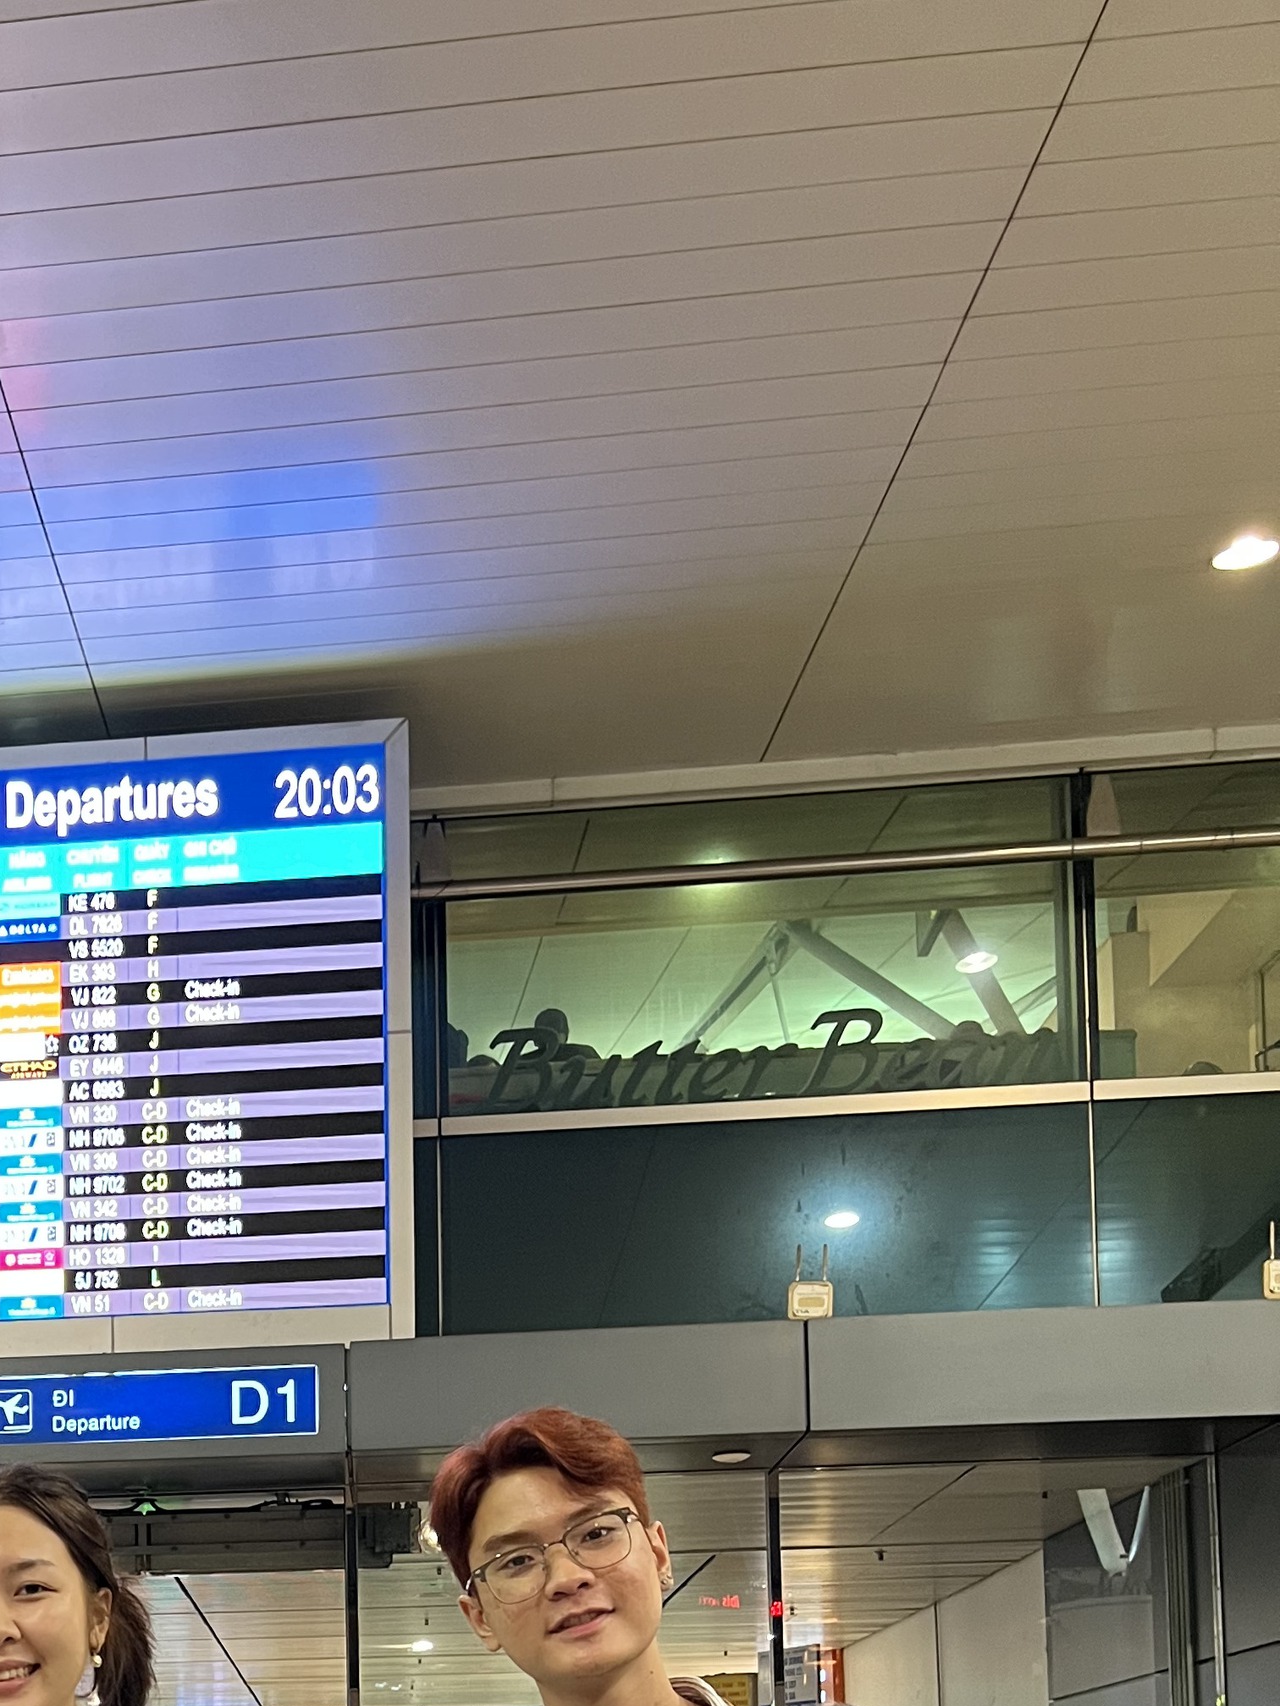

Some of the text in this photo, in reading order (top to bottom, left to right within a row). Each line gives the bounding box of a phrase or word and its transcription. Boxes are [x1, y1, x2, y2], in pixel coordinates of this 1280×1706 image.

[5, 775, 219, 838] Departures
[274, 766, 380, 819] 20:03
[68, 894, 88, 912] KE
[147, 889, 158, 907] F
[69, 918, 88, 936] DL
[147, 913, 158, 931] F
[147, 936, 158, 954] F
[147, 960, 159, 978] H
[71, 989, 90, 1007] VJ
[147, 984, 161, 1002] G
[185, 979, 240, 999] Check-in
[71, 1013, 89, 1031] VJ
[147, 1008, 161, 1026] G
[185, 1003, 240, 1023] Check-in
[69, 1036, 89, 1054] OZ
[149, 1031, 159, 1049] J
[0, 1060, 58, 1074] ETIHAD
[70, 1060, 89, 1078] EY
[149, 1055, 159, 1073] J
[489, 1026, 797, 1102] Butter
[69, 1083, 90, 1101] AC
[149, 1079, 159, 1097] J
[70, 1107, 89, 1125] VN
[93, 1105, 116, 1124] 320
[142, 1103, 168, 1121] C-D
[186, 1098, 241, 1118] Check-in
[69, 1131, 90, 1149] NH
[142, 1126, 168, 1144] C-D
[186, 1122, 241, 1142] Check-in
[70, 1154, 90, 1172] VN
[142, 1150, 168, 1168] C-D
[187, 1146, 241, 1166] Check-in
[69, 1178, 91, 1196] NH
[142, 1174, 168, 1192] C-D
[187, 1169, 241, 1189] Check-in
[70, 1202, 90, 1220] VN
[94, 1200, 117, 1218] 342
[142, 1198, 168, 1216] C-D
[187, 1193, 241, 1213] Check-in
[70, 1225, 91, 1243] NH
[142, 1221, 168, 1239] C-D
[187, 1217, 242, 1237] Check-in
[69, 1249, 91, 1267] HO
[151, 1269, 161, 1287] L
[71, 1296, 91, 1314] VN
[95, 1294, 109, 1312] 51
[142, 1292, 168, 1310] C-D
[188, 1288, 242, 1308] Check-in
[53, 1388, 75, 1408] ĐI
[231, 1378, 298, 1426] D1
[52, 1414, 141, 1436] Departure
